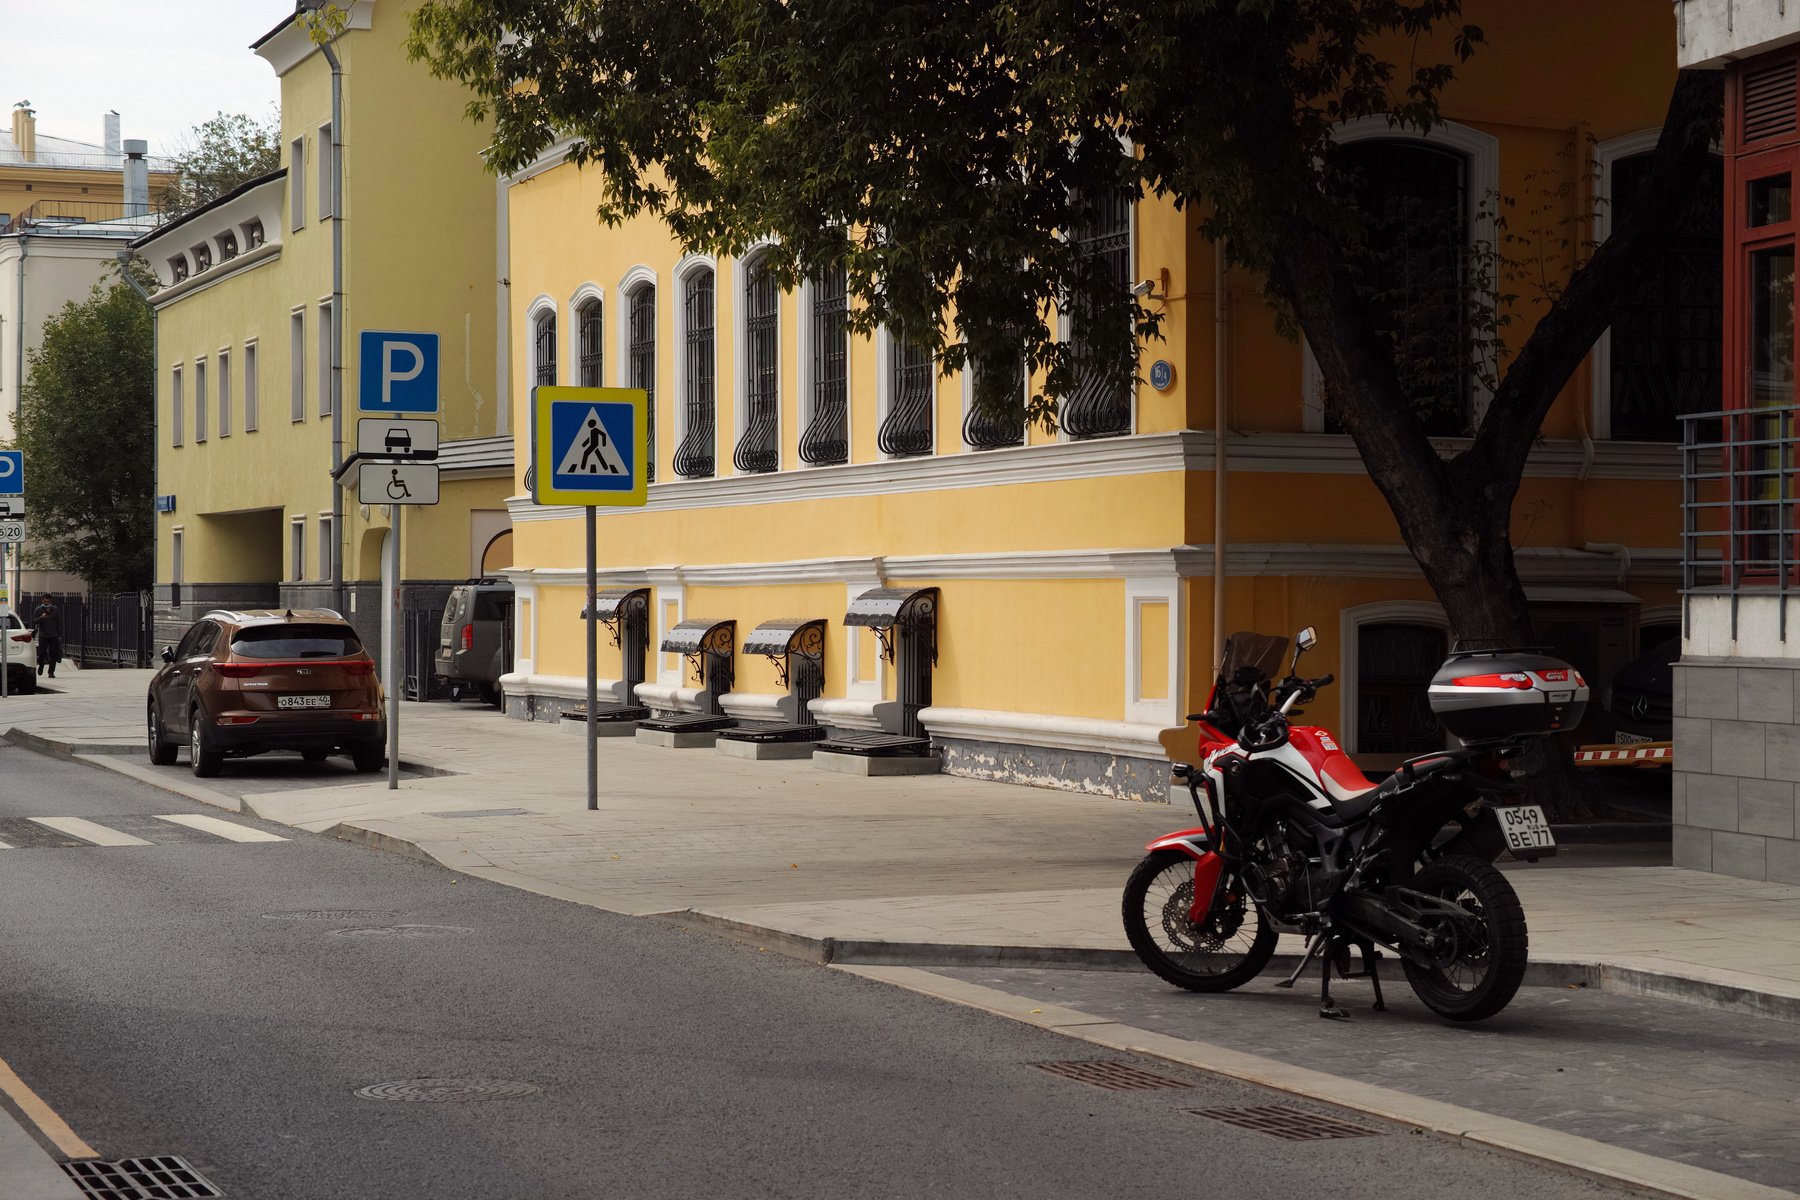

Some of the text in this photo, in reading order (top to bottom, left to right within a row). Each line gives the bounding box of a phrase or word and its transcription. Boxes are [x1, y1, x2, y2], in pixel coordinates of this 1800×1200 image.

[382, 340, 425, 403] P
[7, 527, 20, 537] 20
[1546, 671, 1565, 680] GIVI
[1505, 809, 1538, 825] 0549
[1532, 830, 1549, 845] 77
